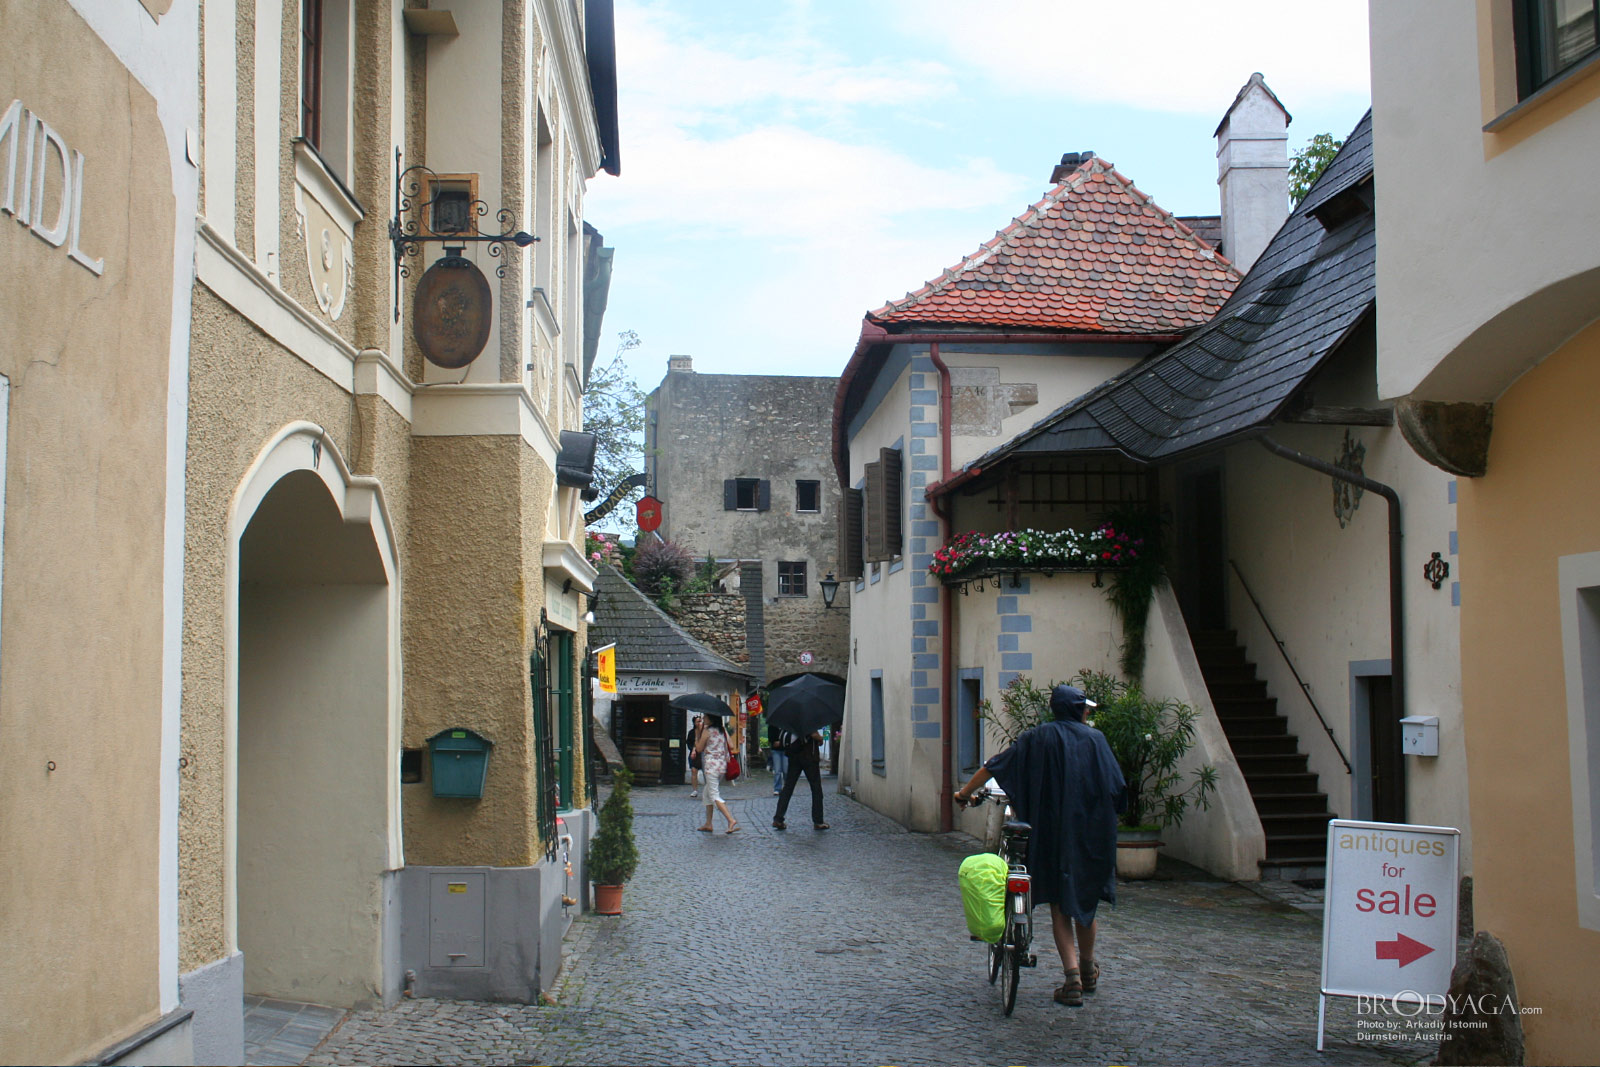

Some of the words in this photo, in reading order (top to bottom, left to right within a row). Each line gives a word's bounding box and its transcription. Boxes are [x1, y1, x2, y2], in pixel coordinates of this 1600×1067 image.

[630, 676, 665, 687] Tränke
[1339, 832, 1445, 858] antiques
[1382, 862, 1406, 878] for
[1355, 884, 1437, 918] sale
